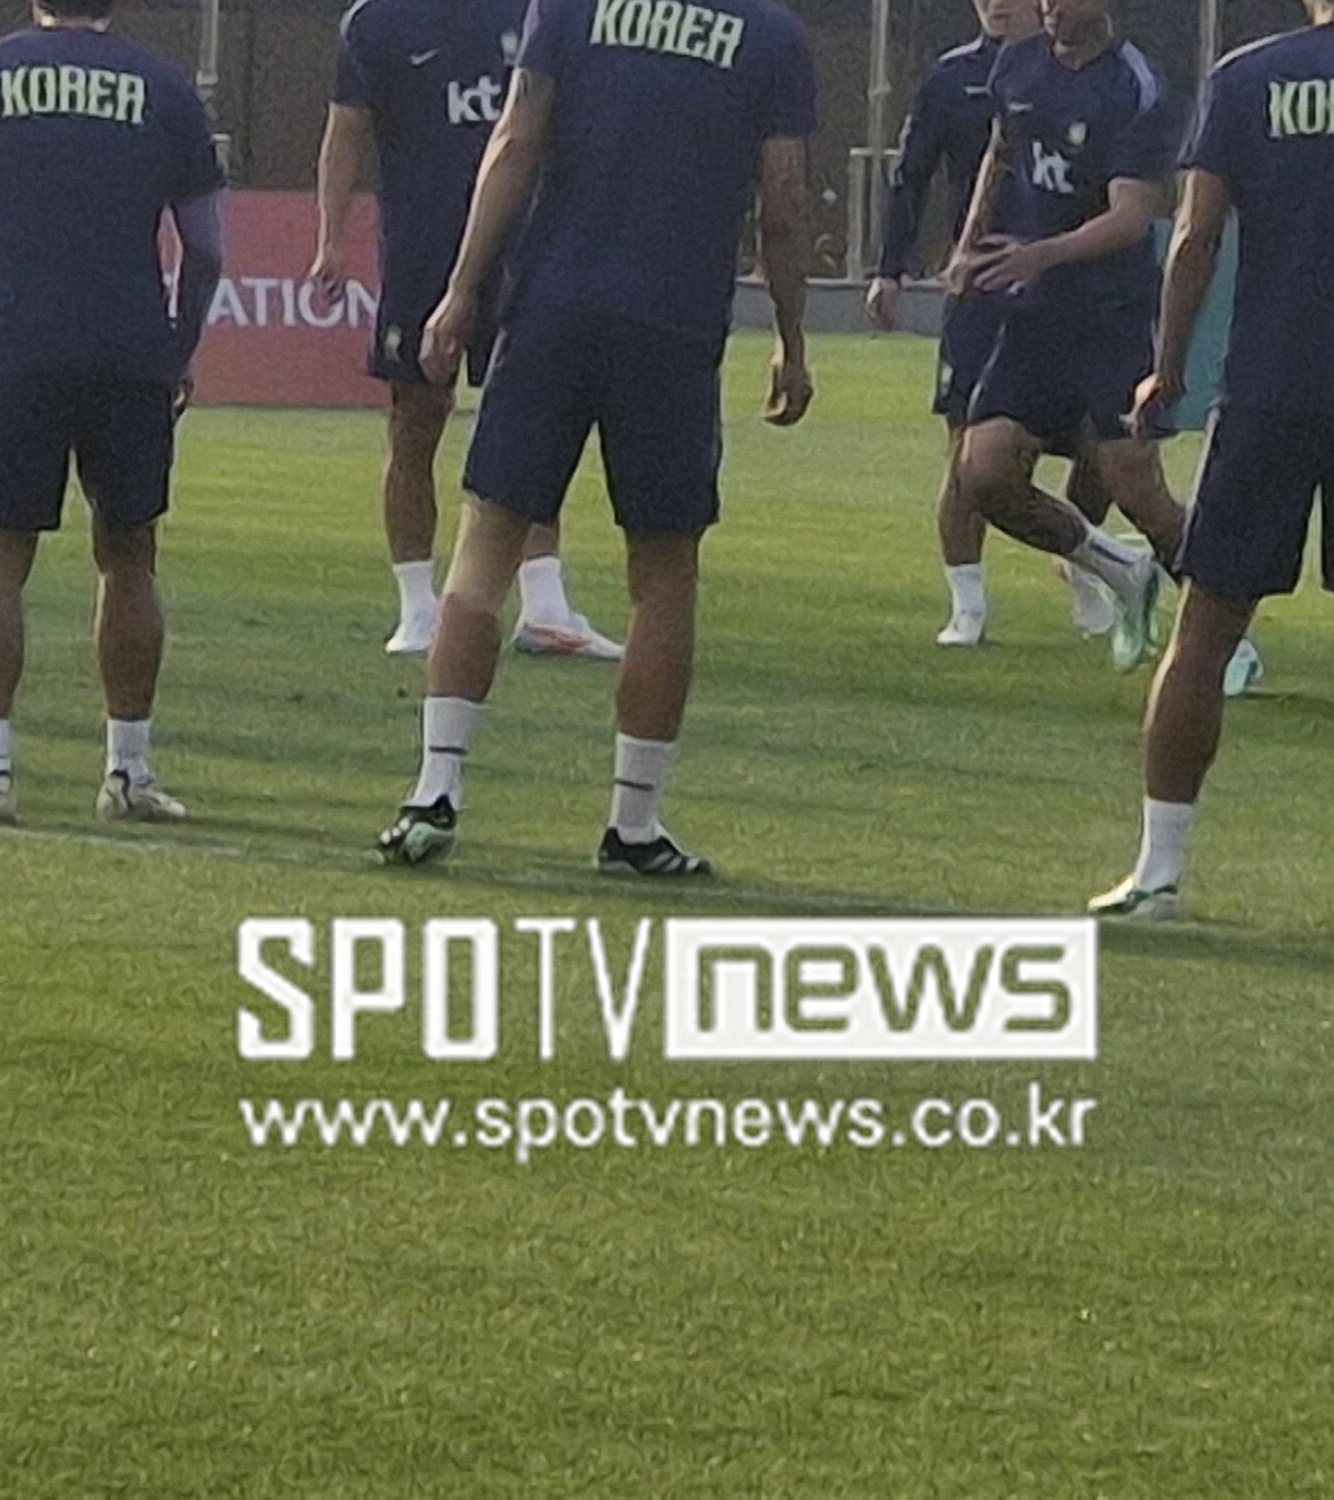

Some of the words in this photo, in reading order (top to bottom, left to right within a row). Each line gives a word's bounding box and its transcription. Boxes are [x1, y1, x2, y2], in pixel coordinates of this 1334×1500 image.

[0, 65, 146, 124] KOREA
[447, 75, 503, 124] kt
[1032, 141, 1075, 194] kt
